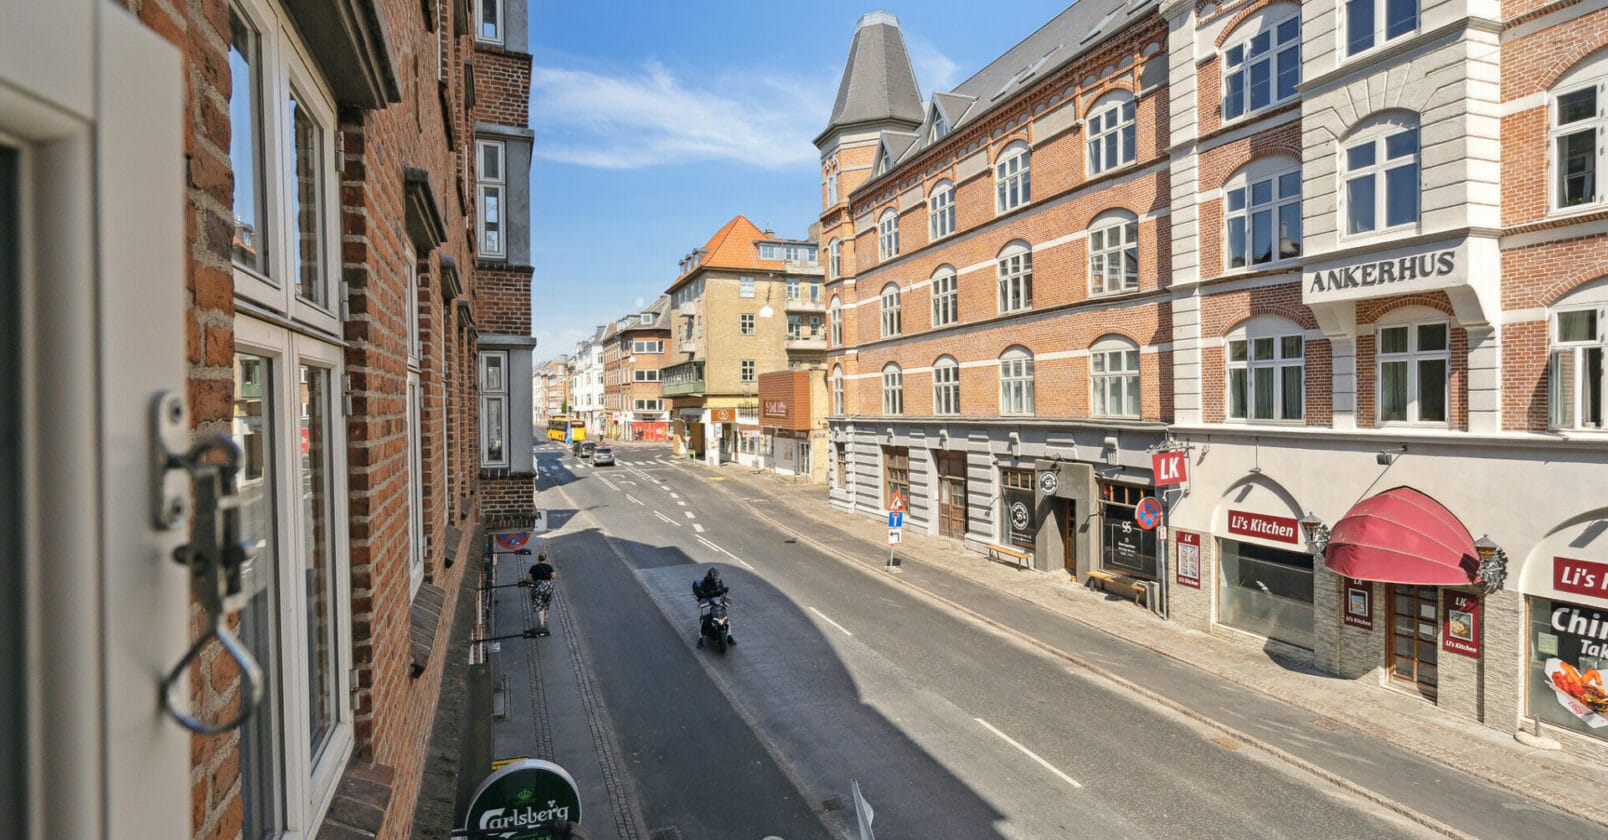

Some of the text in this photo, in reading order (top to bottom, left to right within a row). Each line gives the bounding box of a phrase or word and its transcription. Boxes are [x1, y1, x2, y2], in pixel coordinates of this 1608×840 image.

[1310, 251, 1455, 293] ANKERHUS
[1160, 457, 1180, 480] LK
[1231, 515, 1294, 538] Li's Kitchen
[1561, 566, 1596, 588] Li's
[1455, 596, 1467, 607] LK
[480, 801, 569, 831] Carlsberg
